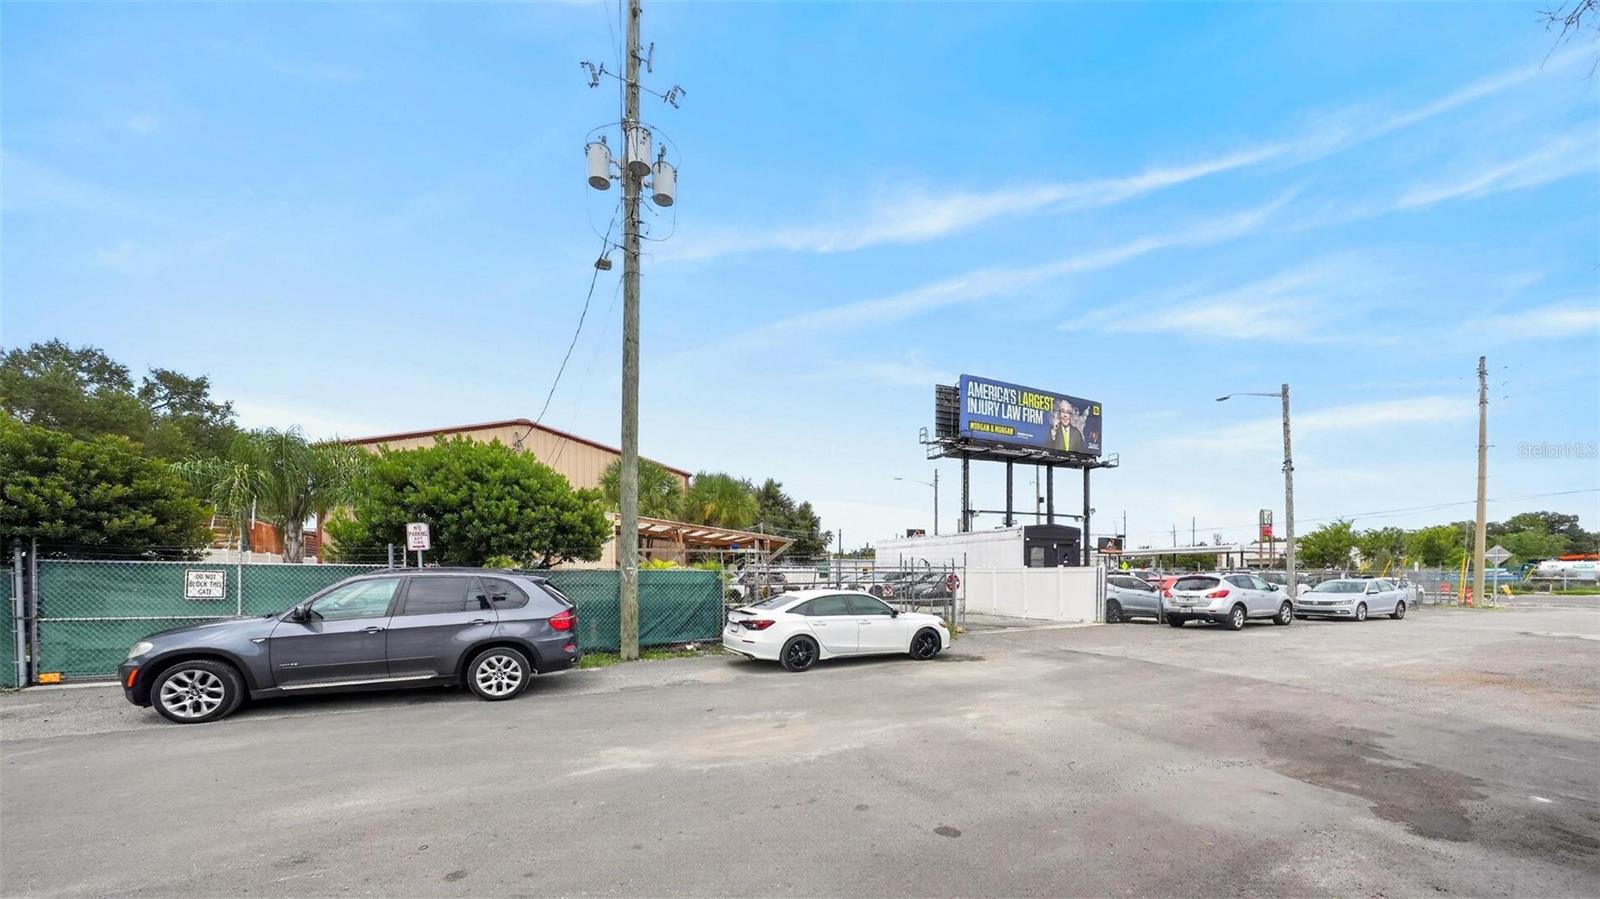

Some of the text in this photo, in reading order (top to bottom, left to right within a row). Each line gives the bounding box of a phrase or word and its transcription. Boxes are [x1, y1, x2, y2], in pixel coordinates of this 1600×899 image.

[968, 381, 1054, 411] AMERICA'S LARGEST
[968, 397, 1043, 424] INJURY LAW FIRM
